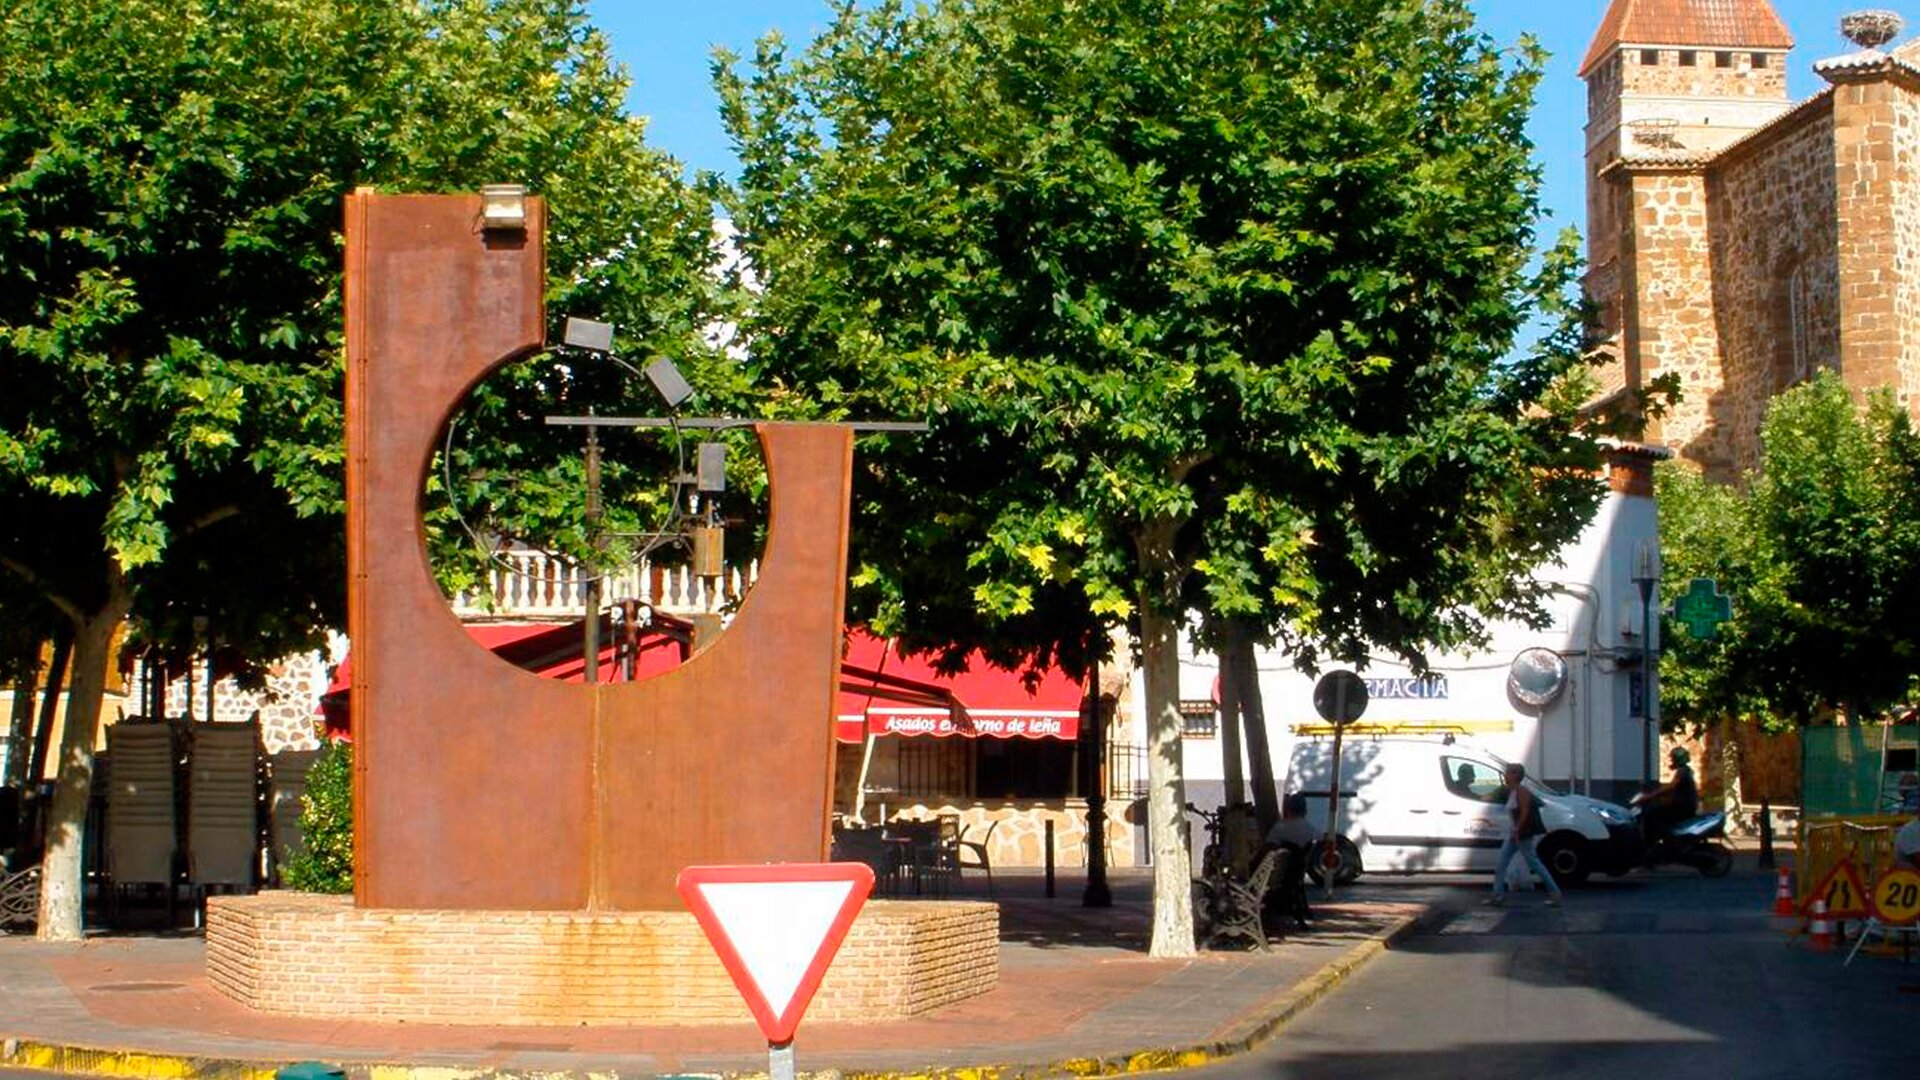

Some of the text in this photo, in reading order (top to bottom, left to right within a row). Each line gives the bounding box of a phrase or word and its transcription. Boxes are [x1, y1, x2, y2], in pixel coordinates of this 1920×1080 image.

[1364, 678, 1448, 698] RMACIA
[884, 715, 936, 731] Asados
[1006, 717, 1025, 732] de
[1029, 717, 1061, 734] leña
[1885, 881, 1918, 908] 20
